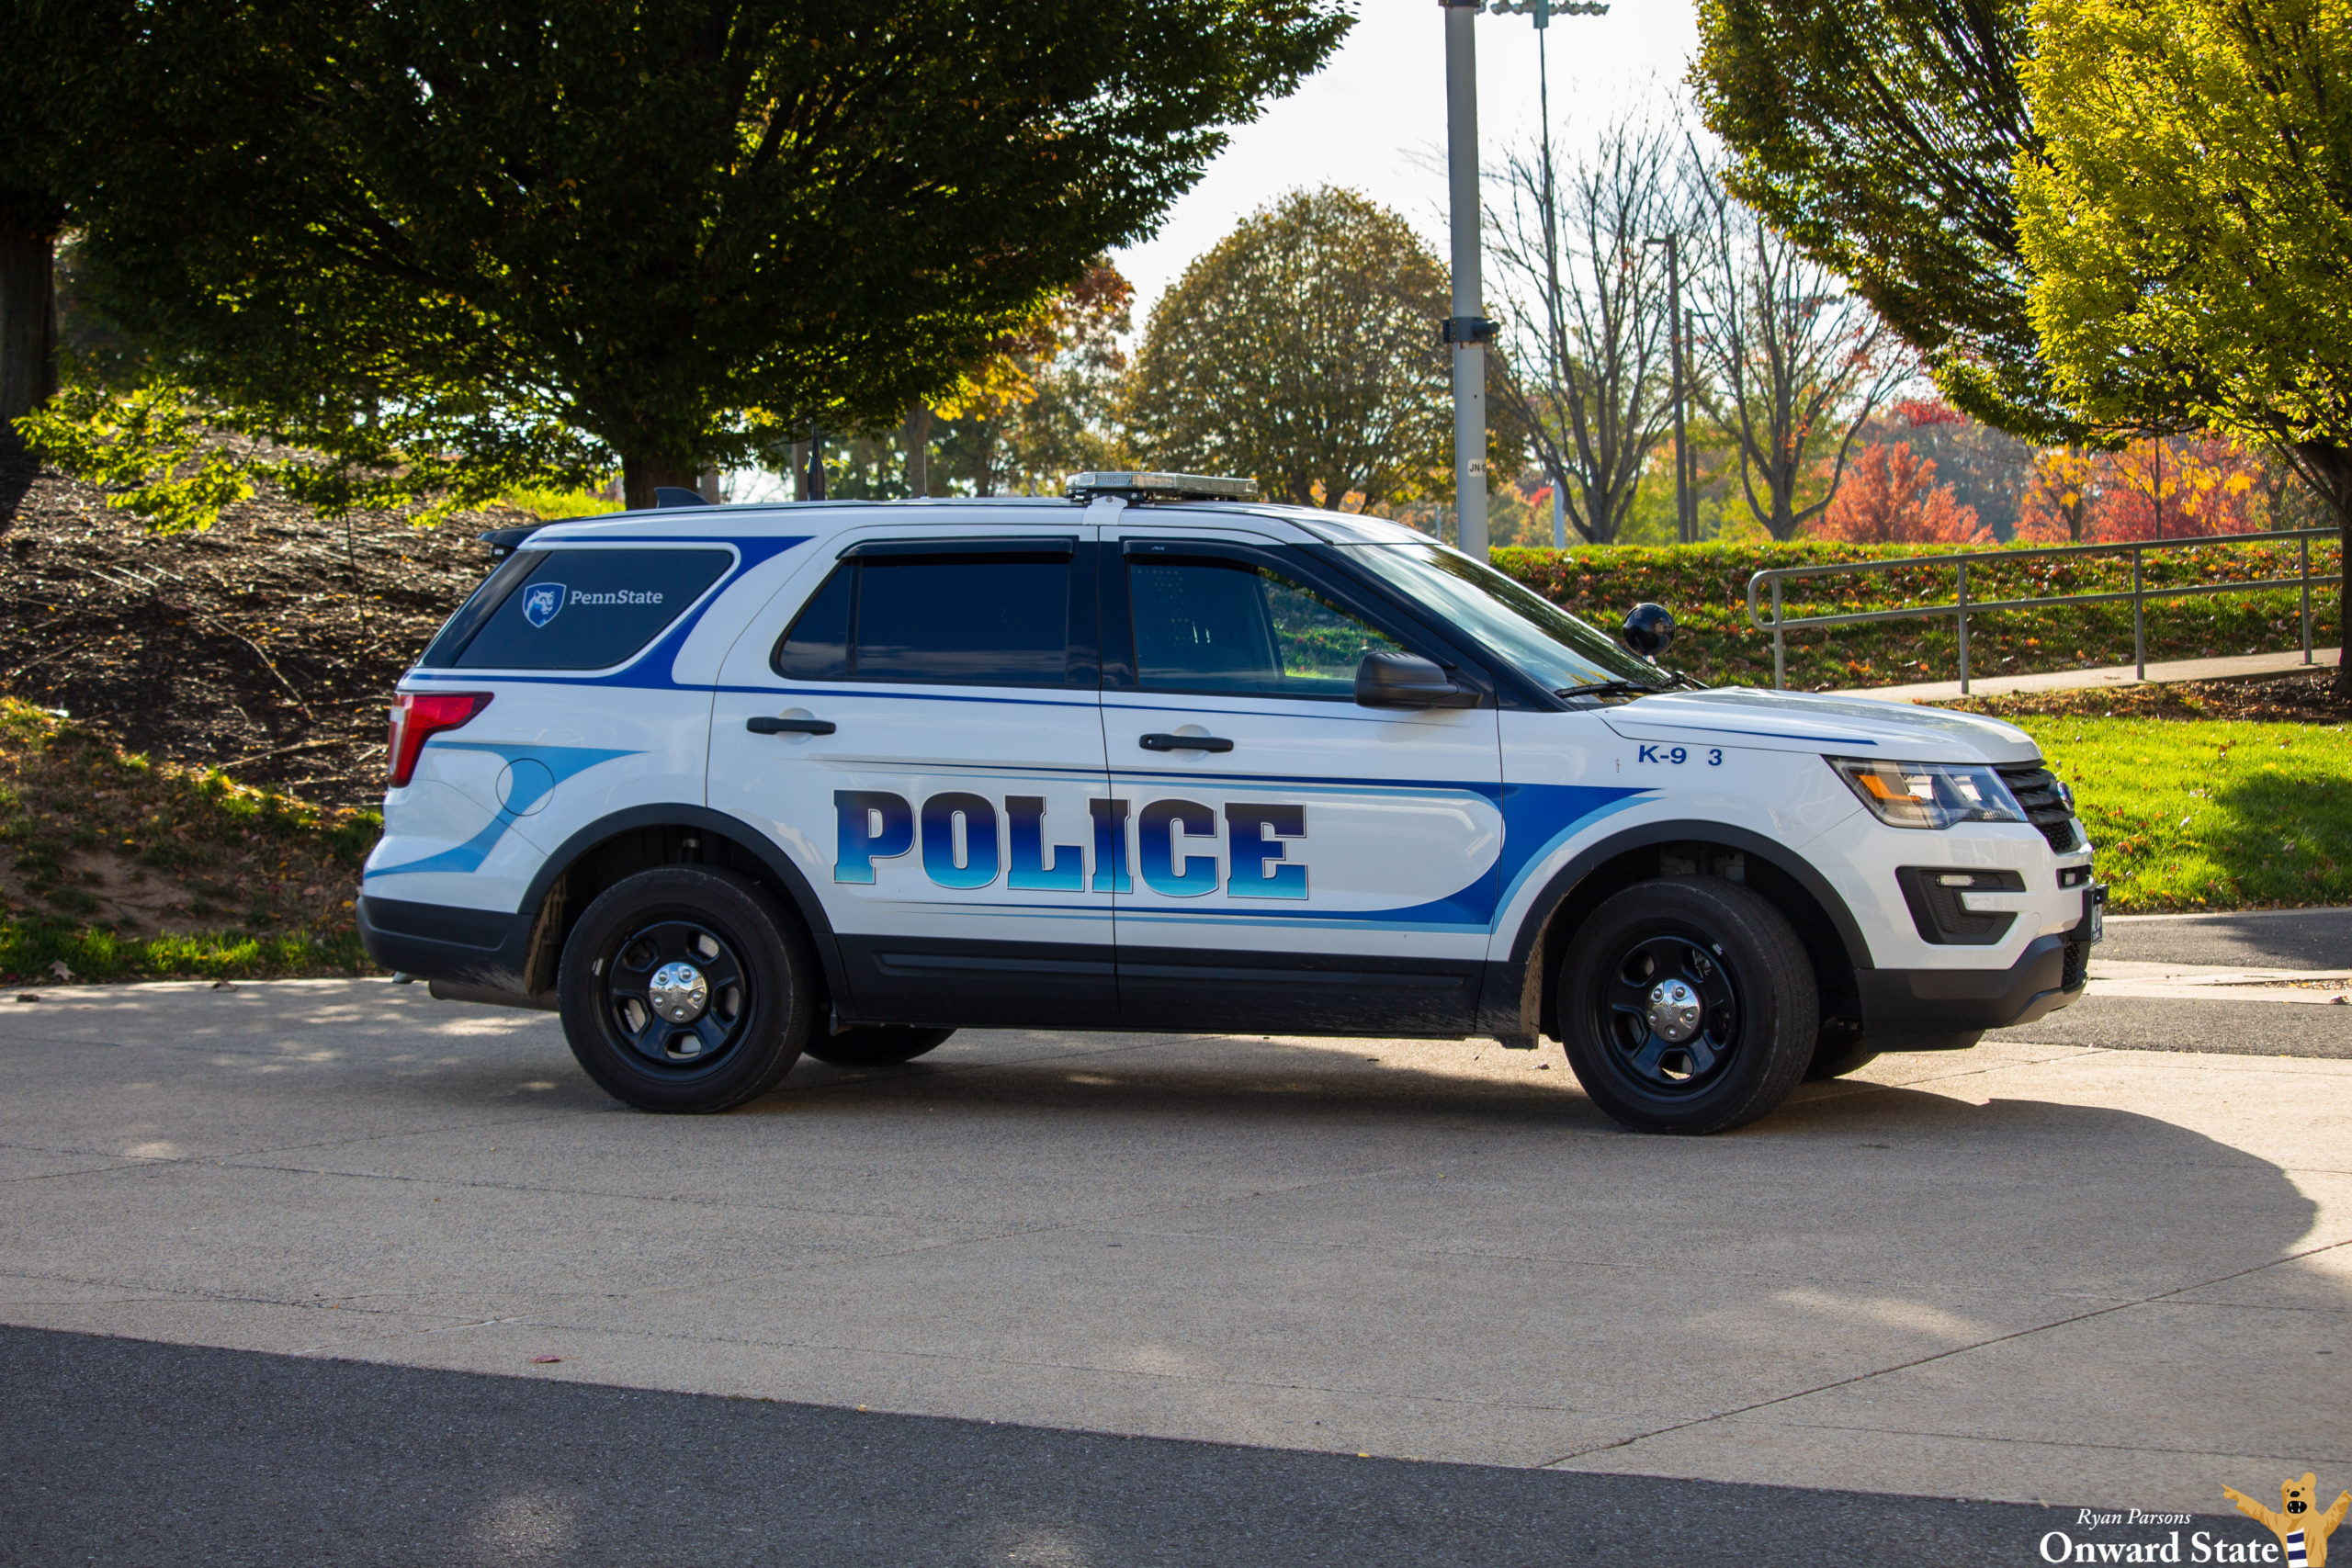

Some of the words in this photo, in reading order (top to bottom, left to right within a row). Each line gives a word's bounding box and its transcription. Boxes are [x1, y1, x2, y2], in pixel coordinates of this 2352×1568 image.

[570, 589, 663, 605] PennState
[1638, 744, 1688, 765] K-9
[1707, 748, 1724, 767] 3
[832, 788, 1309, 901] POLICE
